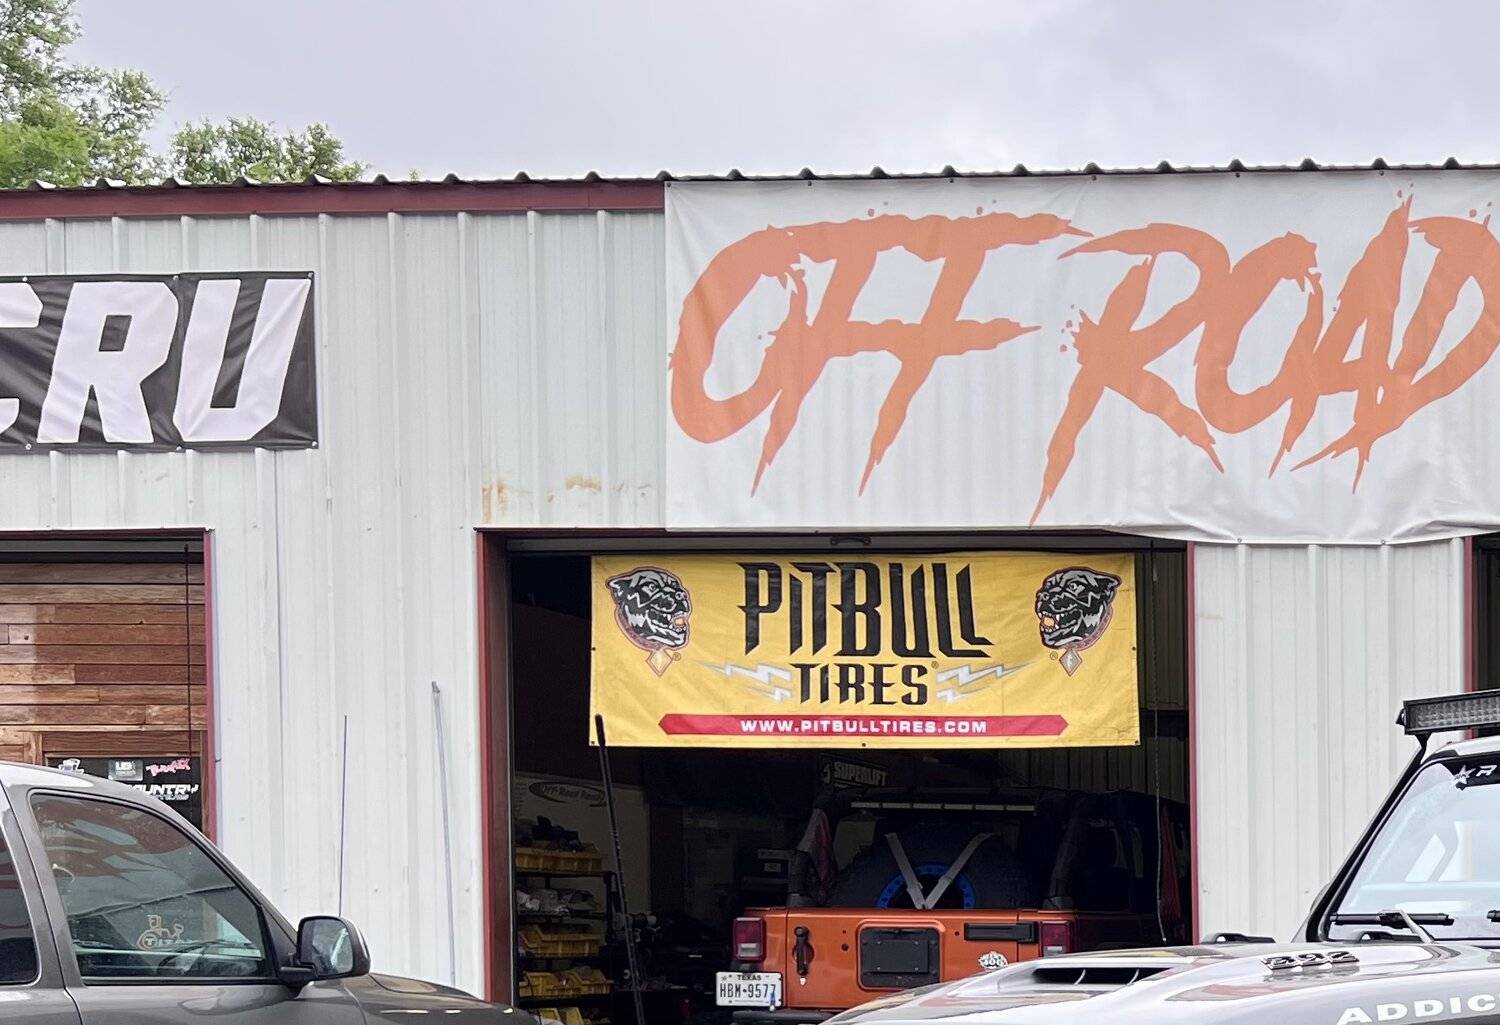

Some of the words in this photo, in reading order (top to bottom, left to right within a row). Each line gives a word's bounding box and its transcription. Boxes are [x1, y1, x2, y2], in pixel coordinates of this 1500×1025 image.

[669, 205, 1094, 498] OFF
[737, 561, 994, 658] PITBULL
[789, 662, 928, 706] TIRES
[741, 719, 987, 734] WWW.PITBULLTIRES.COM
